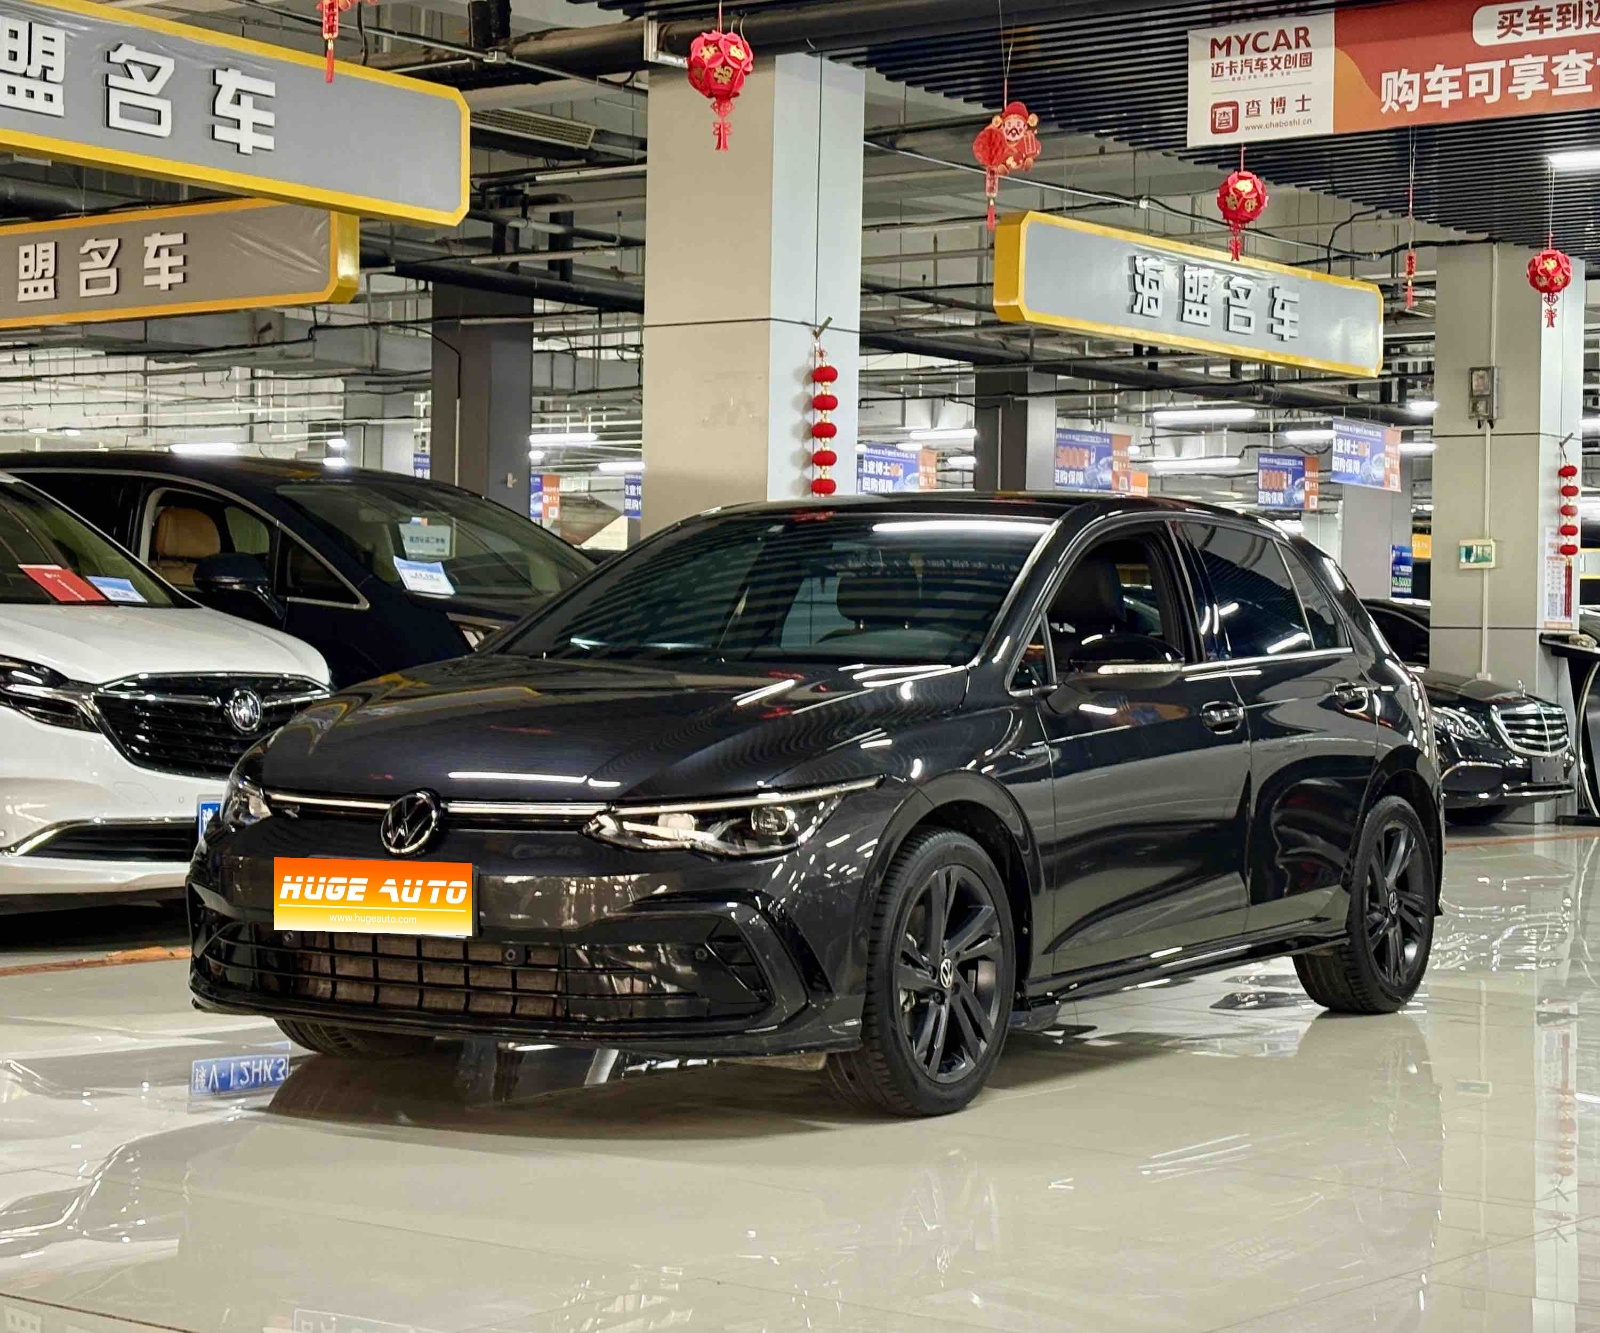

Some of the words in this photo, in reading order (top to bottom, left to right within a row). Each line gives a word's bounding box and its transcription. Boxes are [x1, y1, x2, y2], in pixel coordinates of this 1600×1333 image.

[1210, 26, 1312, 59] MYCAR
[1211, 51, 1313, 78] 迈卡汽车文创园
[0, 19, 277, 155] 盟名车
[1380, 49, 1600, 114] 购车可享查
[1244, 118, 1312, 132] www.chaboshi.cn
[1245, 94, 1312, 119] 查博士
[17, 231, 187, 303] 盟名车
[1130, 255, 1300, 342] 海盟名车
